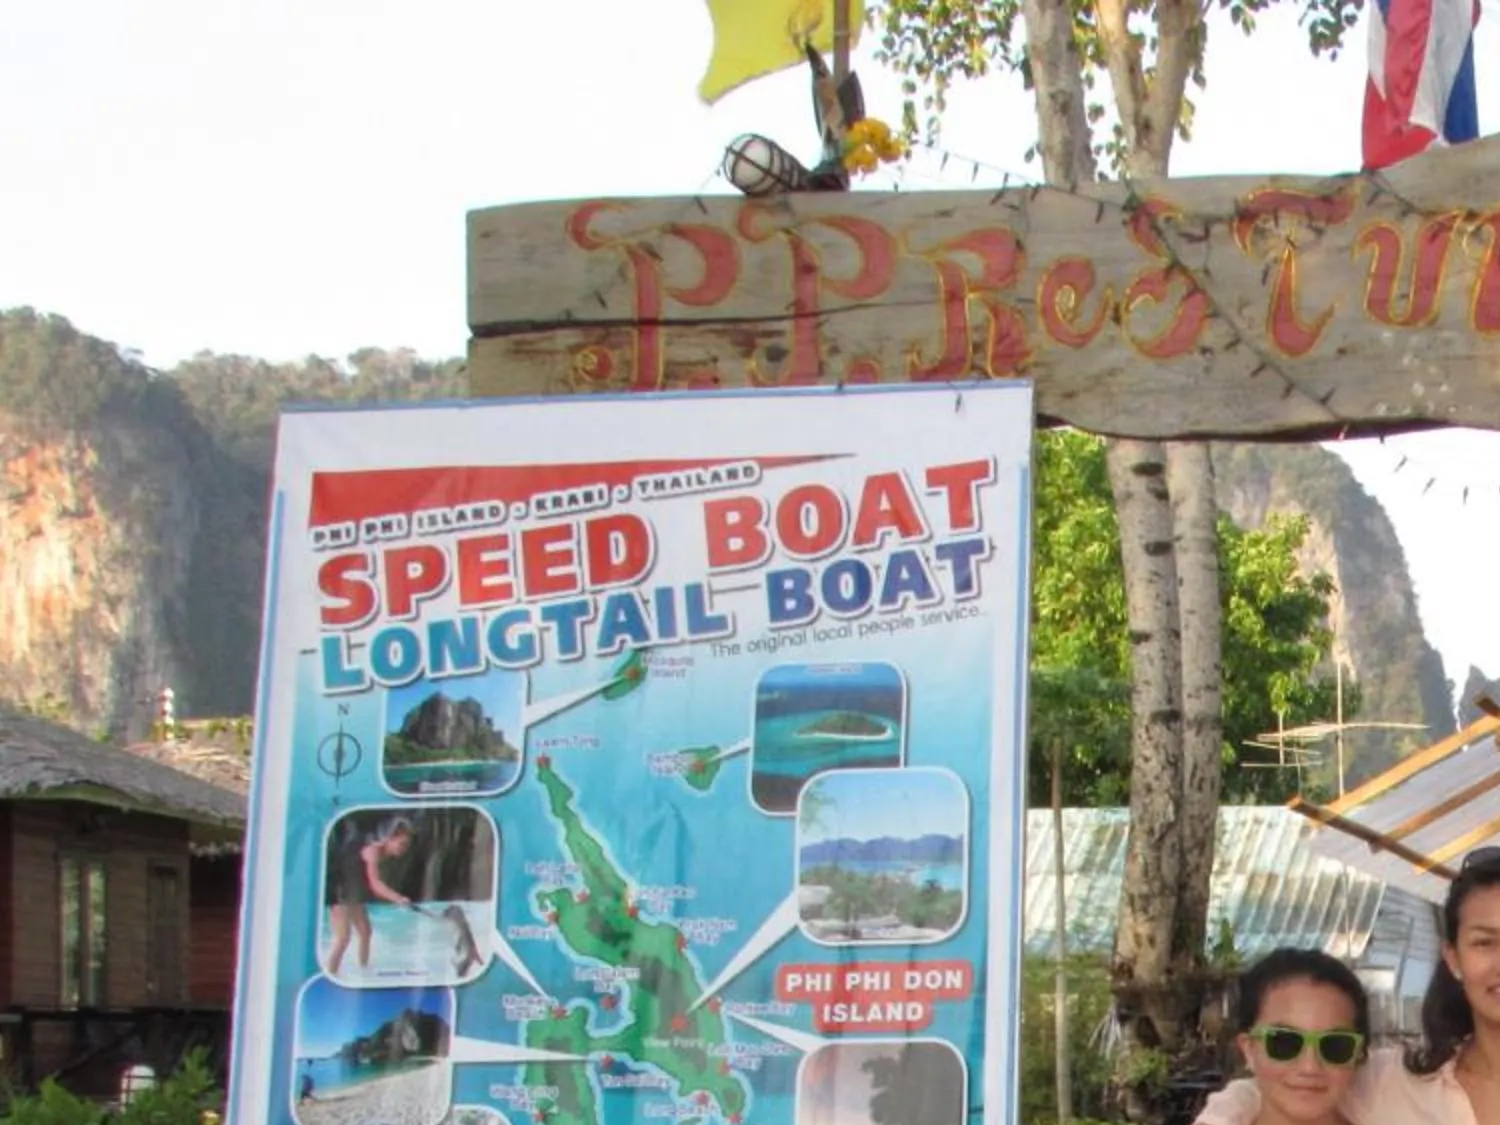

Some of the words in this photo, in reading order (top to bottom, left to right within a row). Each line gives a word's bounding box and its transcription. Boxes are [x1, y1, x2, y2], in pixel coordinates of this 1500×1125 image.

[313, 528, 353, 544] PHI
[365, 520, 405, 536] PHI
[418, 505, 501, 530] ISLAND
[535, 488, 605, 511] KRABI
[637, 466, 755, 494] THAILAND
[317, 513, 651, 625] SPEED
[703, 459, 991, 568] BOAT
[321, 583, 729, 689] LONGTAIL
[765, 539, 986, 623] BOAT
[711, 642, 742, 657] The
[747, 632, 807, 654] original
[813, 620, 852, 640] local
[859, 616, 914, 639] people
[786, 973, 832, 993] PHI
[845, 972, 891, 992] PHI
[904, 969, 963, 990] DON
[823, 1002, 924, 1023] ISLAND
